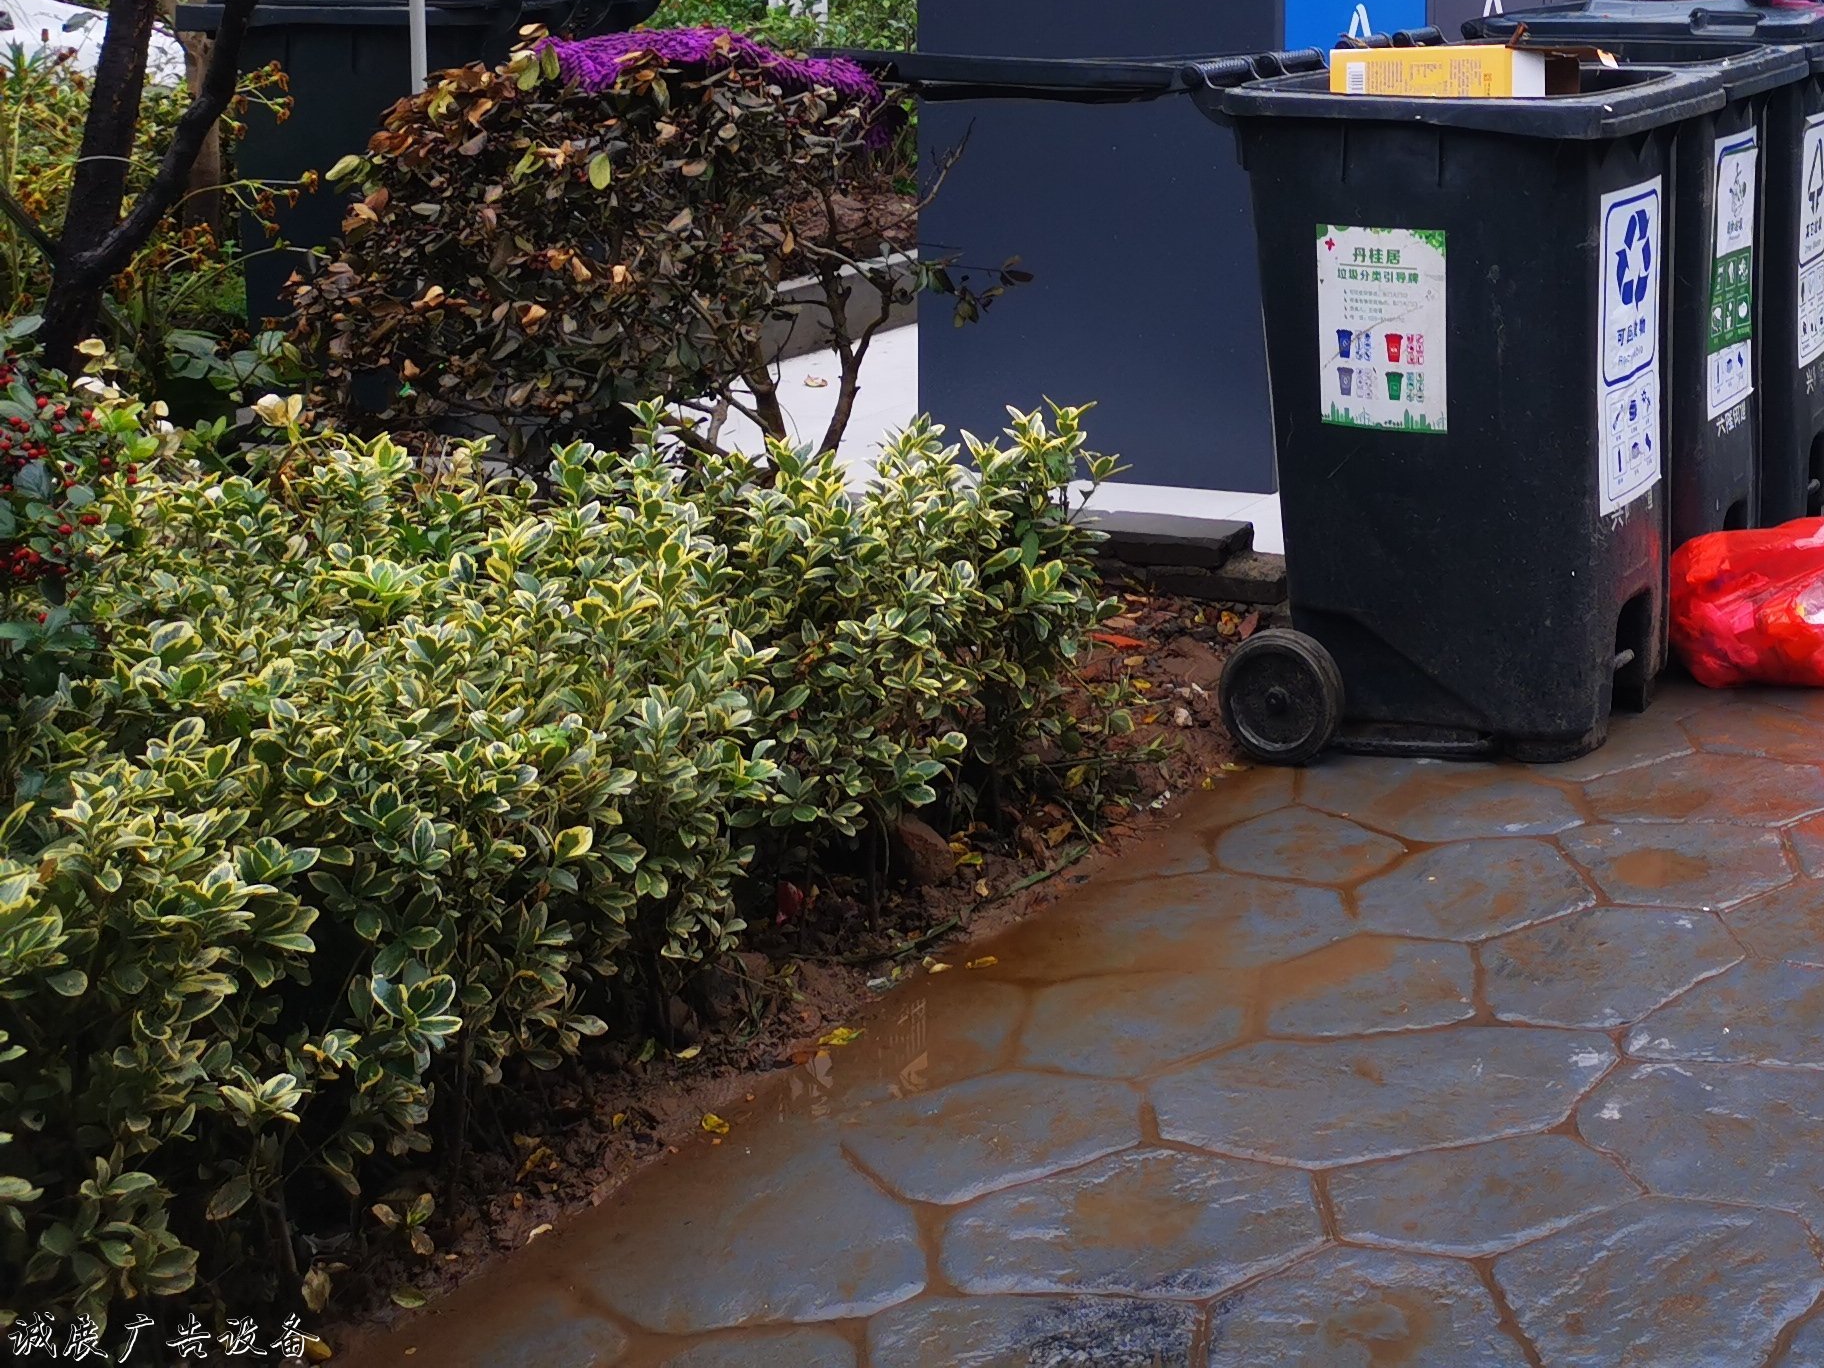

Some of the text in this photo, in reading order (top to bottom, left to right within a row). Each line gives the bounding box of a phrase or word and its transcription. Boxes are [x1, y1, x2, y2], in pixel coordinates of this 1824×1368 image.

[1352, 247, 1401, 265] 丹桂居
[1337, 267, 1419, 284] 垃圾分类引导牌
